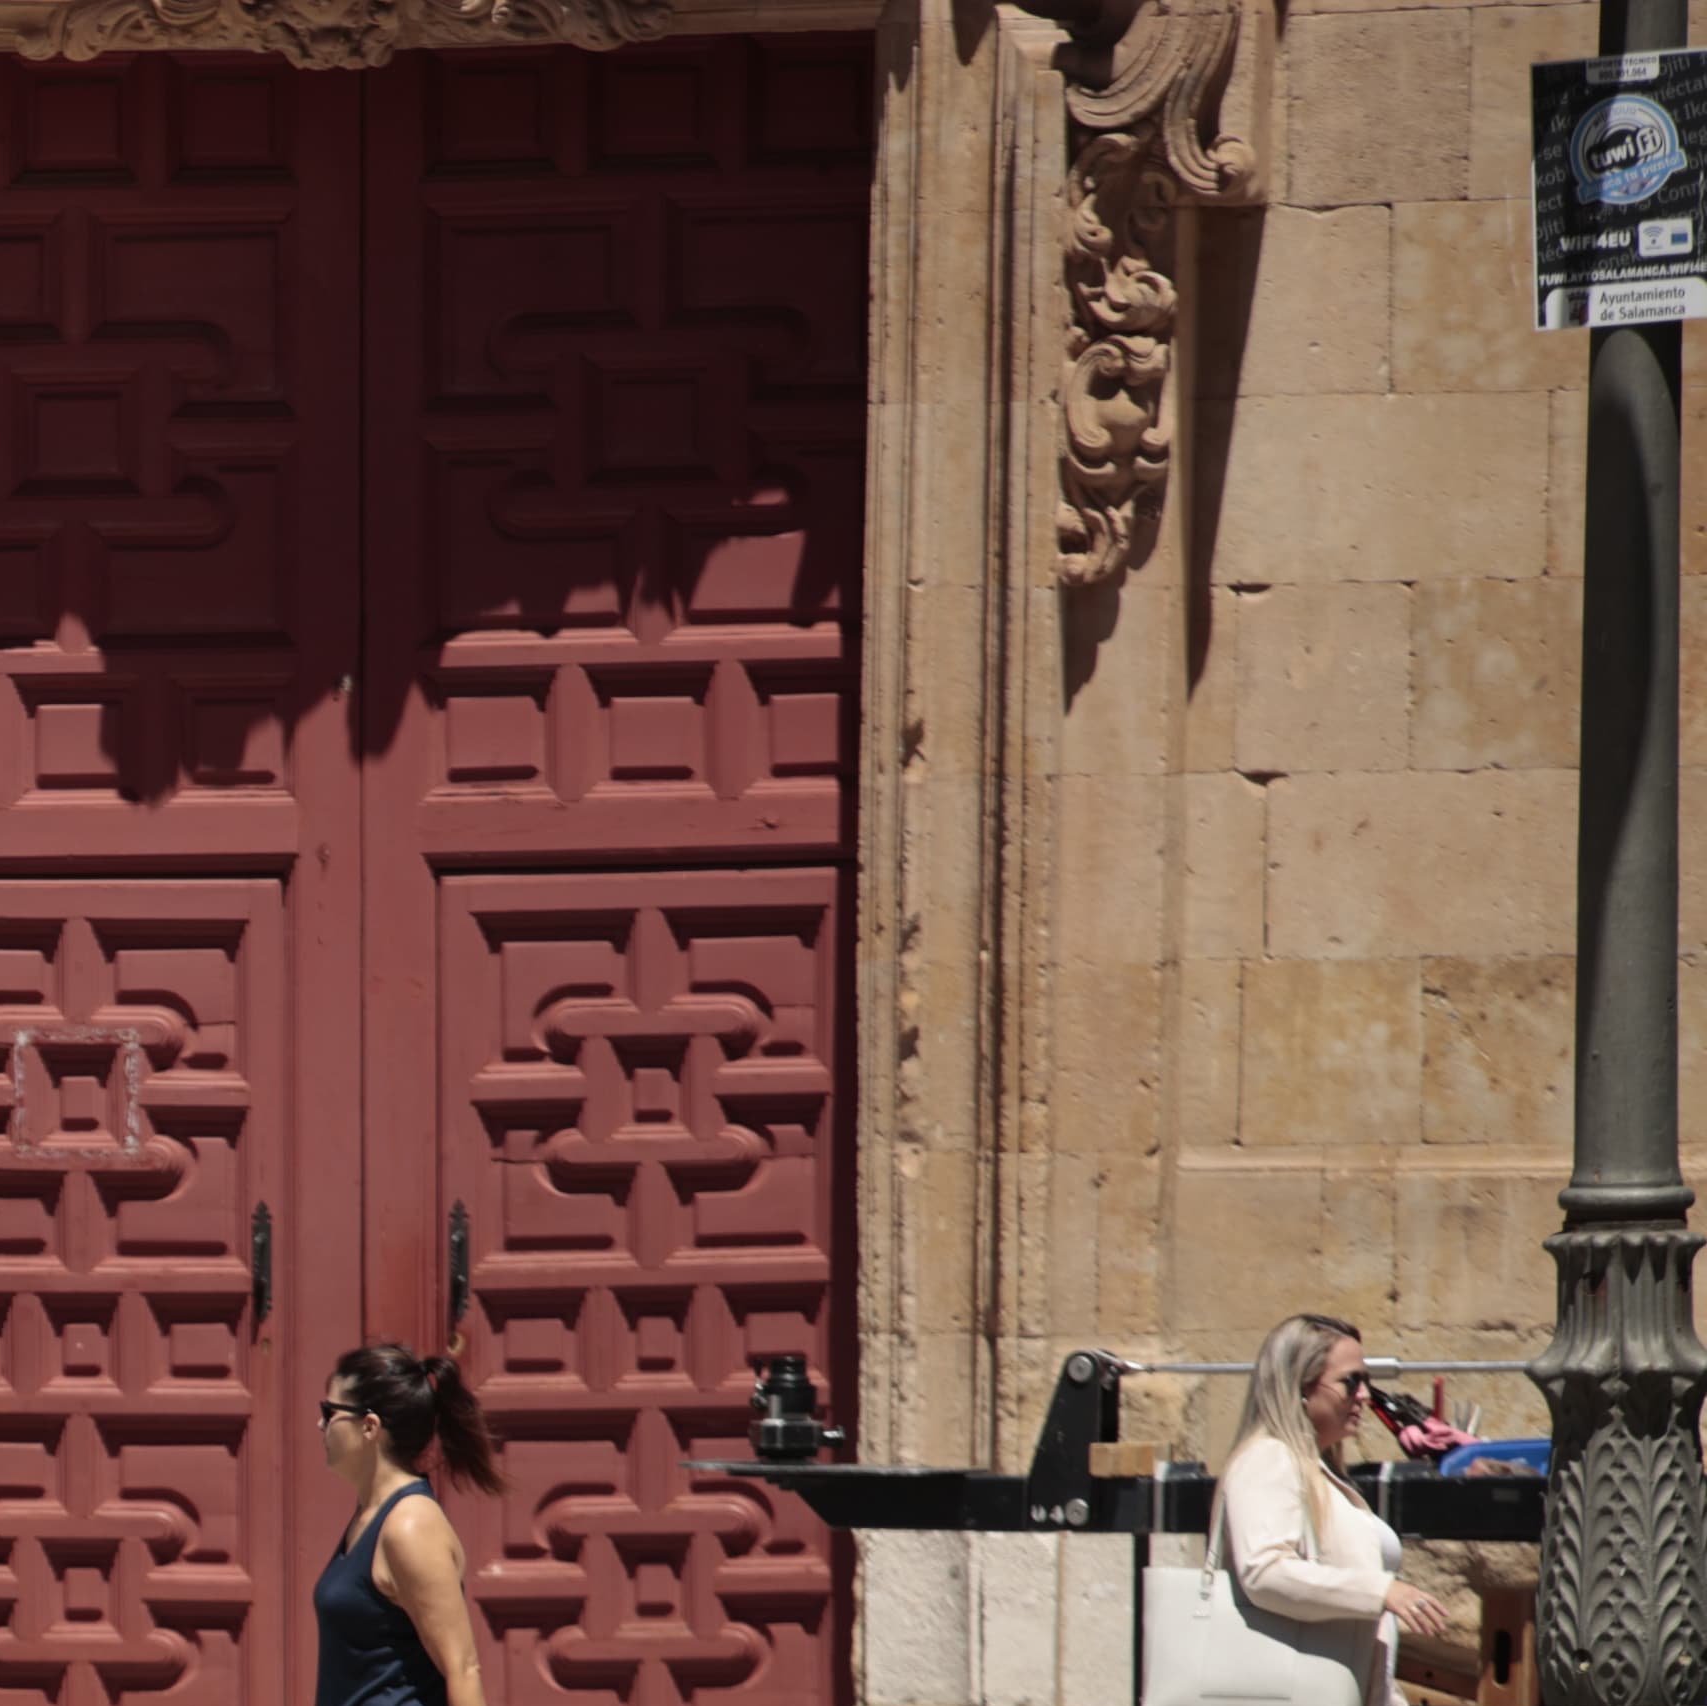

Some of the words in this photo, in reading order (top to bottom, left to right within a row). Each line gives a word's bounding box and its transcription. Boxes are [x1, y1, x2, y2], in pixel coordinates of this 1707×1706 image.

[1599, 286, 1686, 305] Ayuntamiento
[1600, 307, 1615, 321] de
[1619, 303, 1686, 320] Salamanca
